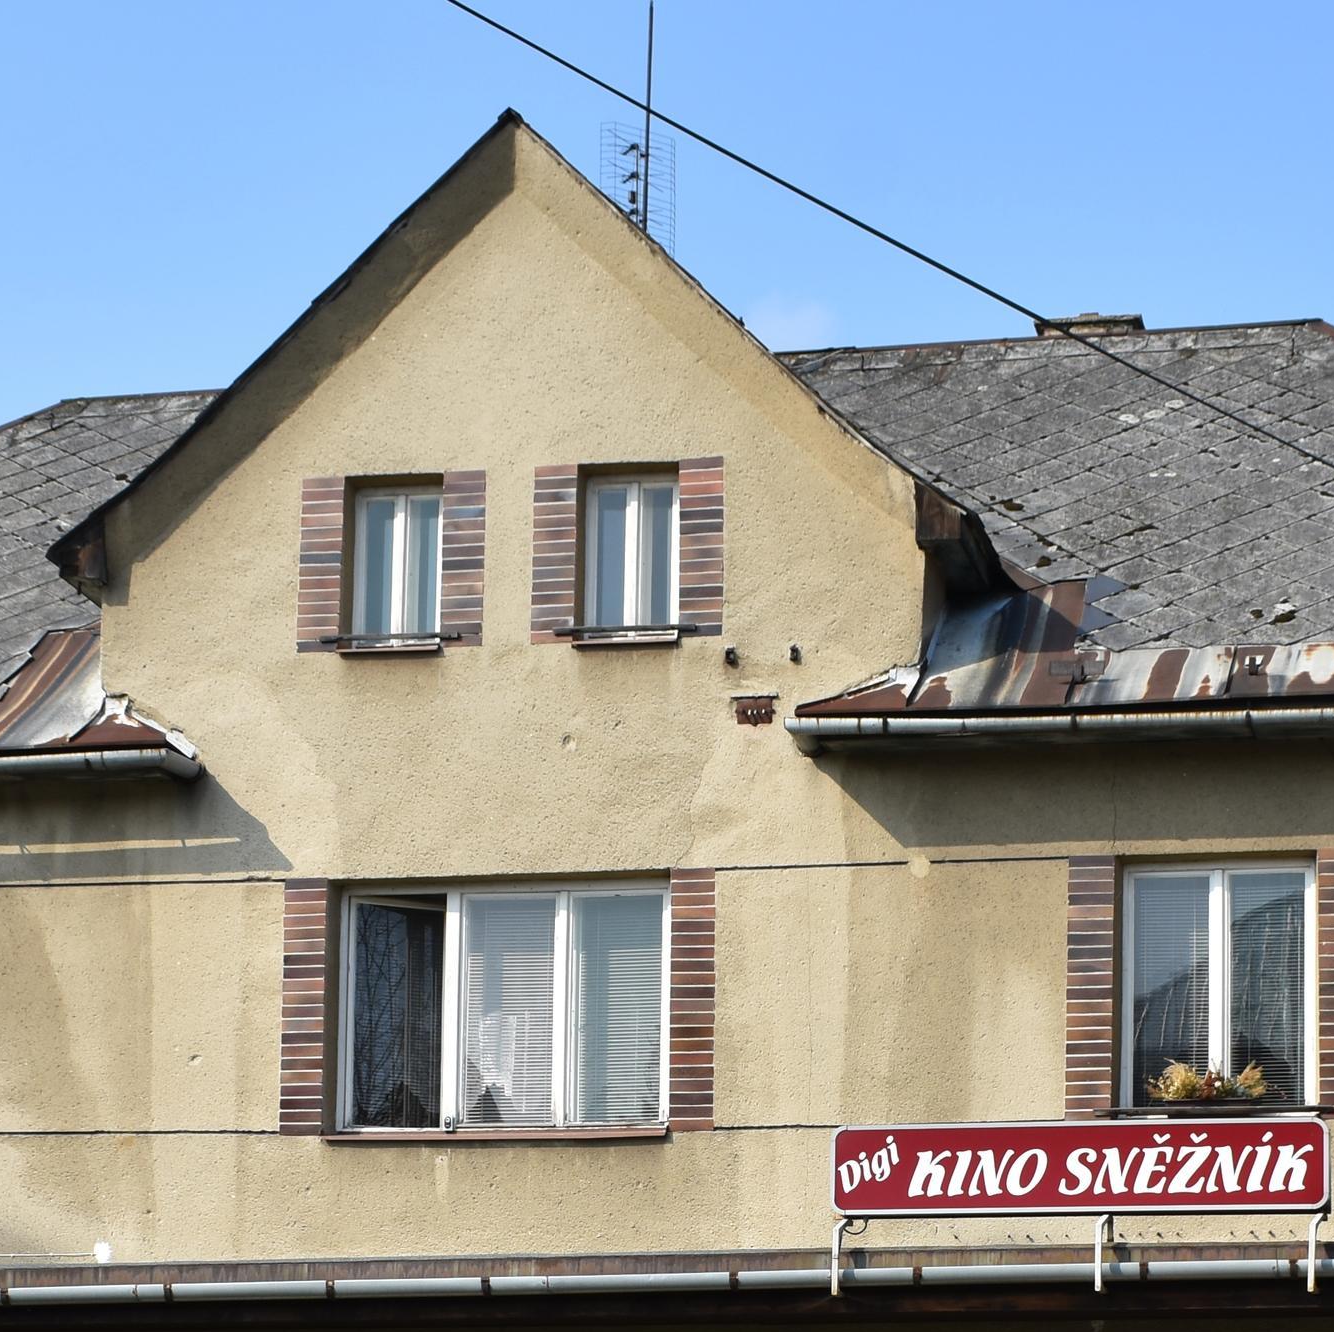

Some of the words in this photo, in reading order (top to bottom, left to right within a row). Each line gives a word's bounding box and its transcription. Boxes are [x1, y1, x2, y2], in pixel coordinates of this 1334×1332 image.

[837, 1134, 900, 1194] Digi
[907, 1148, 1049, 1199] KINO
[1058, 1131, 1314, 1196] SNĚŽNÍK
